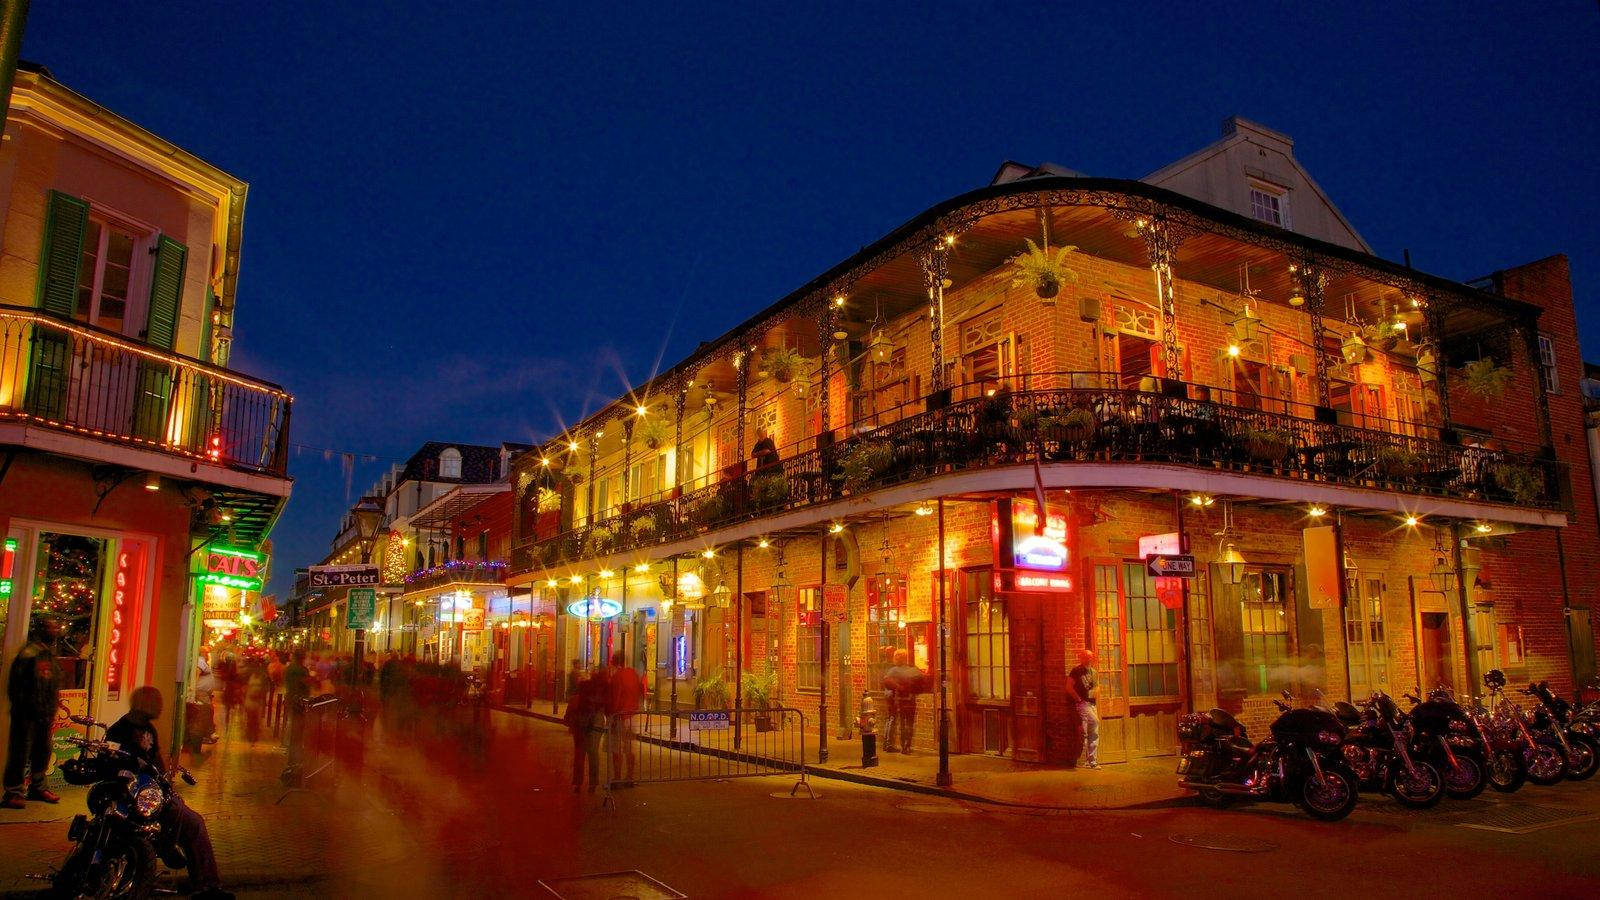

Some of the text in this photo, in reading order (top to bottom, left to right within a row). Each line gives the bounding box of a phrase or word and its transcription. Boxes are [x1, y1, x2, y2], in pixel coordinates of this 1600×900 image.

[1162, 560, 1191, 571] ONE WAY
[313, 573, 376, 585] St. Peter
[107, 553, 128, 683] KARAOKE
